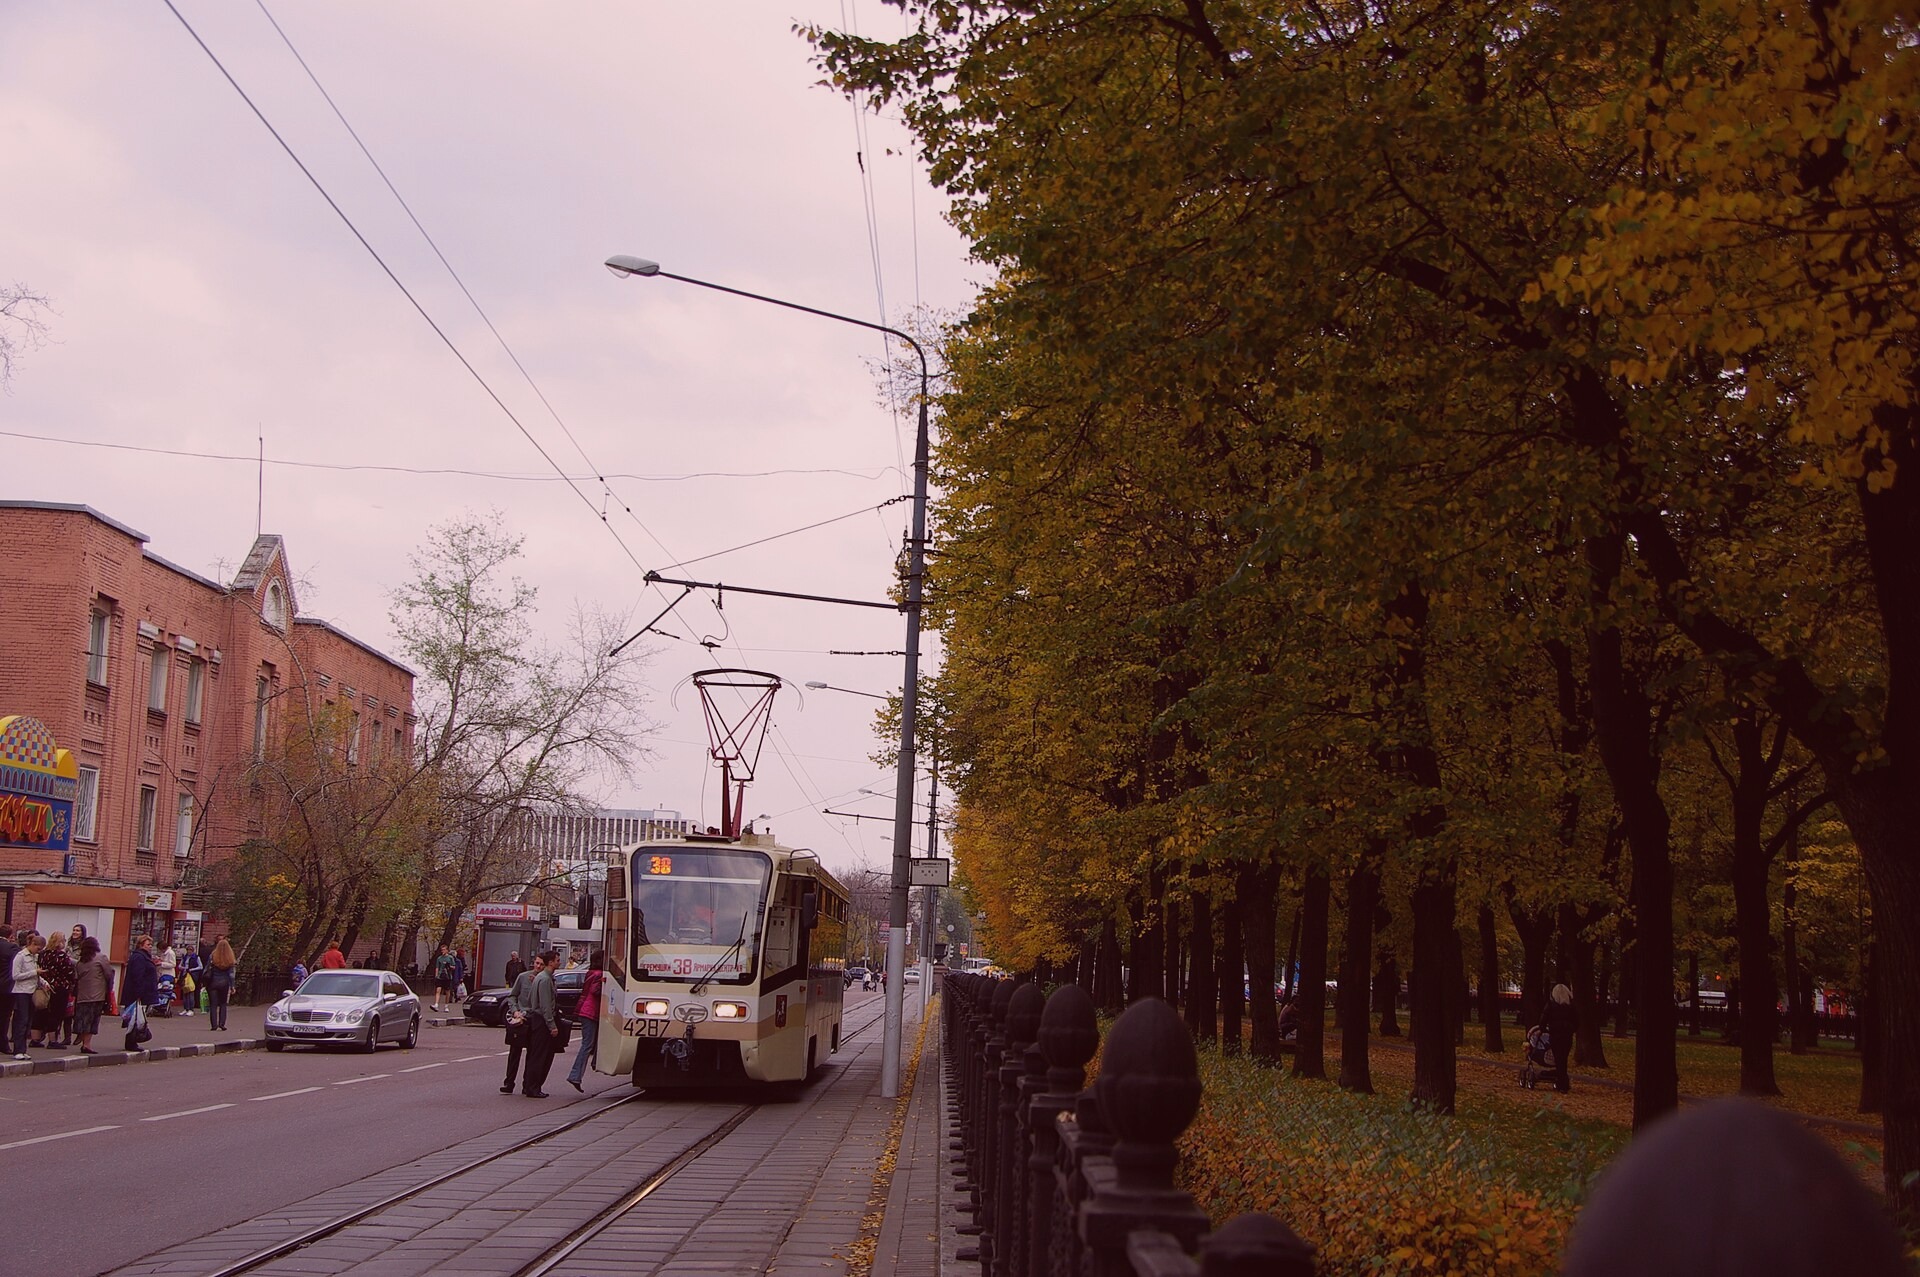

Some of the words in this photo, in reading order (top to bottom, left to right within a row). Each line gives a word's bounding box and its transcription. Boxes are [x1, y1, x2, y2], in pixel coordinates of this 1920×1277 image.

[651, 856, 671, 874] 38
[673, 959, 692, 975] 38
[624, 1018, 670, 1037] 4287
